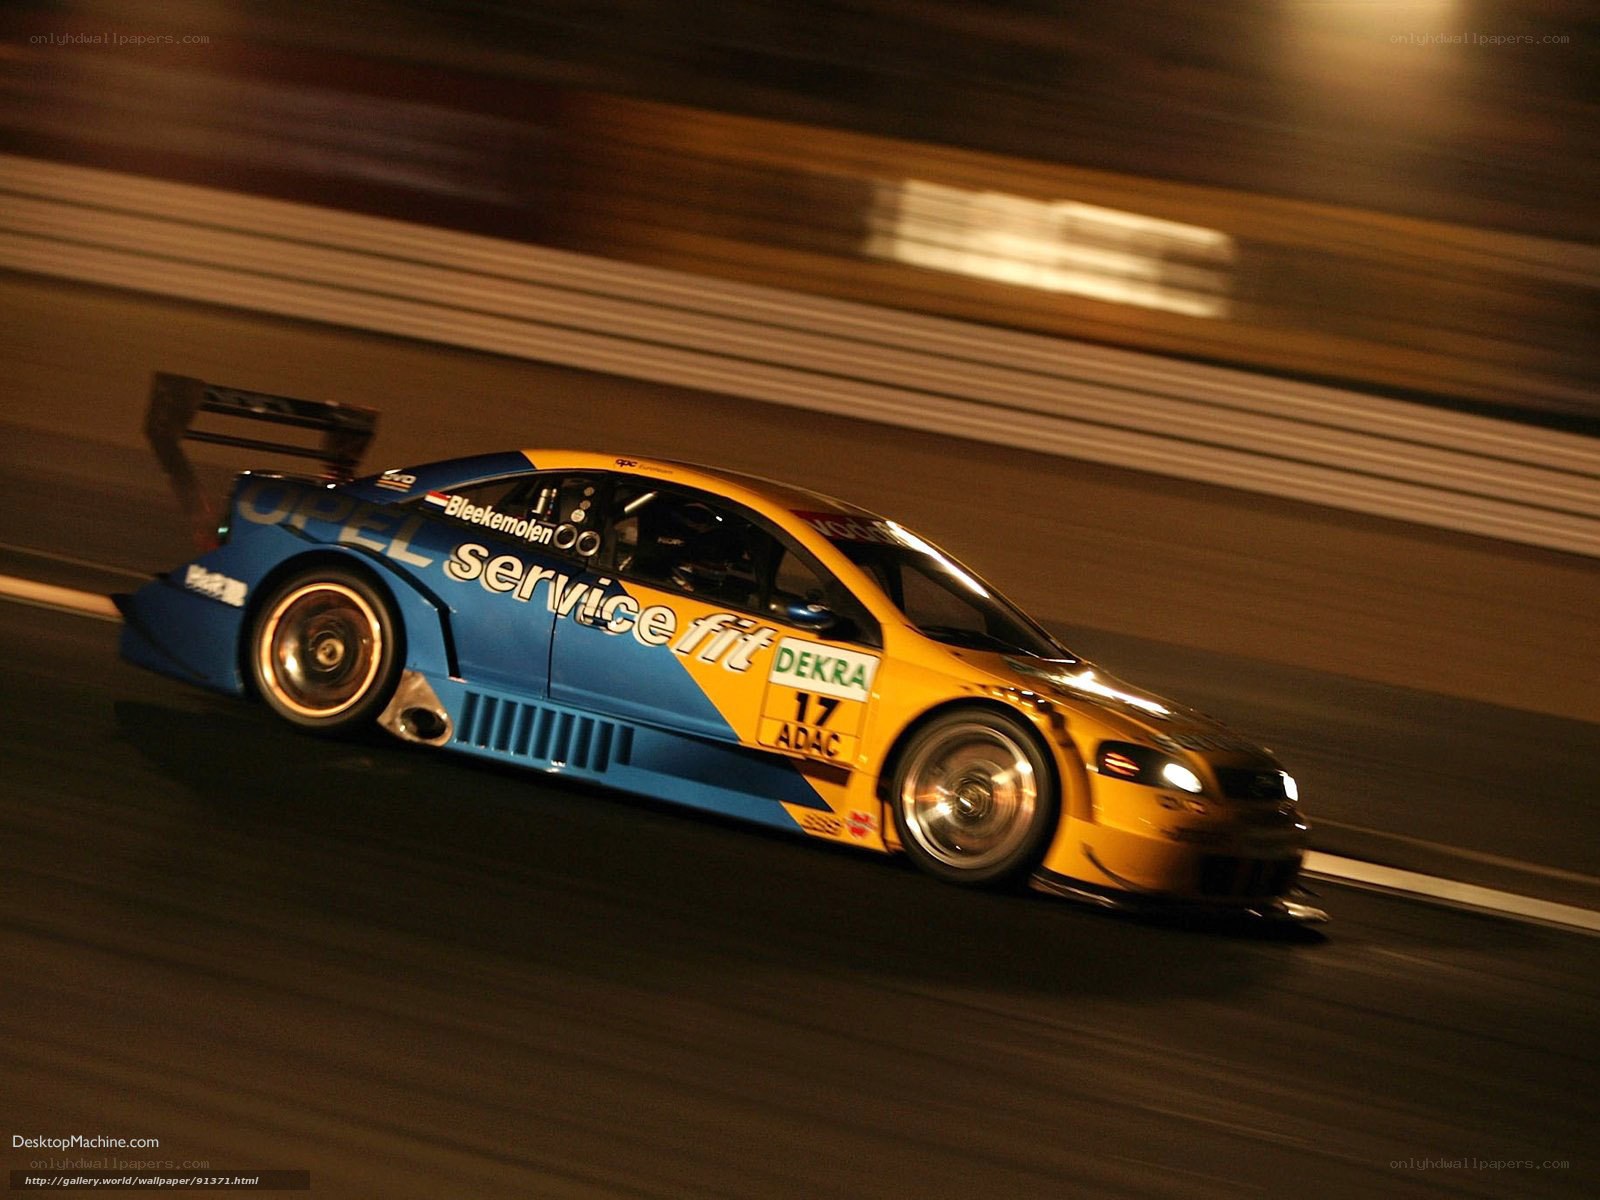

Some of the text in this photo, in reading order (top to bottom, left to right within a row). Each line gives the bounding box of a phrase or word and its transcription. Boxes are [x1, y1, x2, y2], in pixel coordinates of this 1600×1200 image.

[237, 477, 434, 568] OPEL
[444, 495, 553, 545] Bleekemolen
[443, 542, 779, 673] service fit
[774, 646, 869, 692] DEKRA
[795, 691, 841, 727] 17
[775, 722, 842, 758] ADAC
